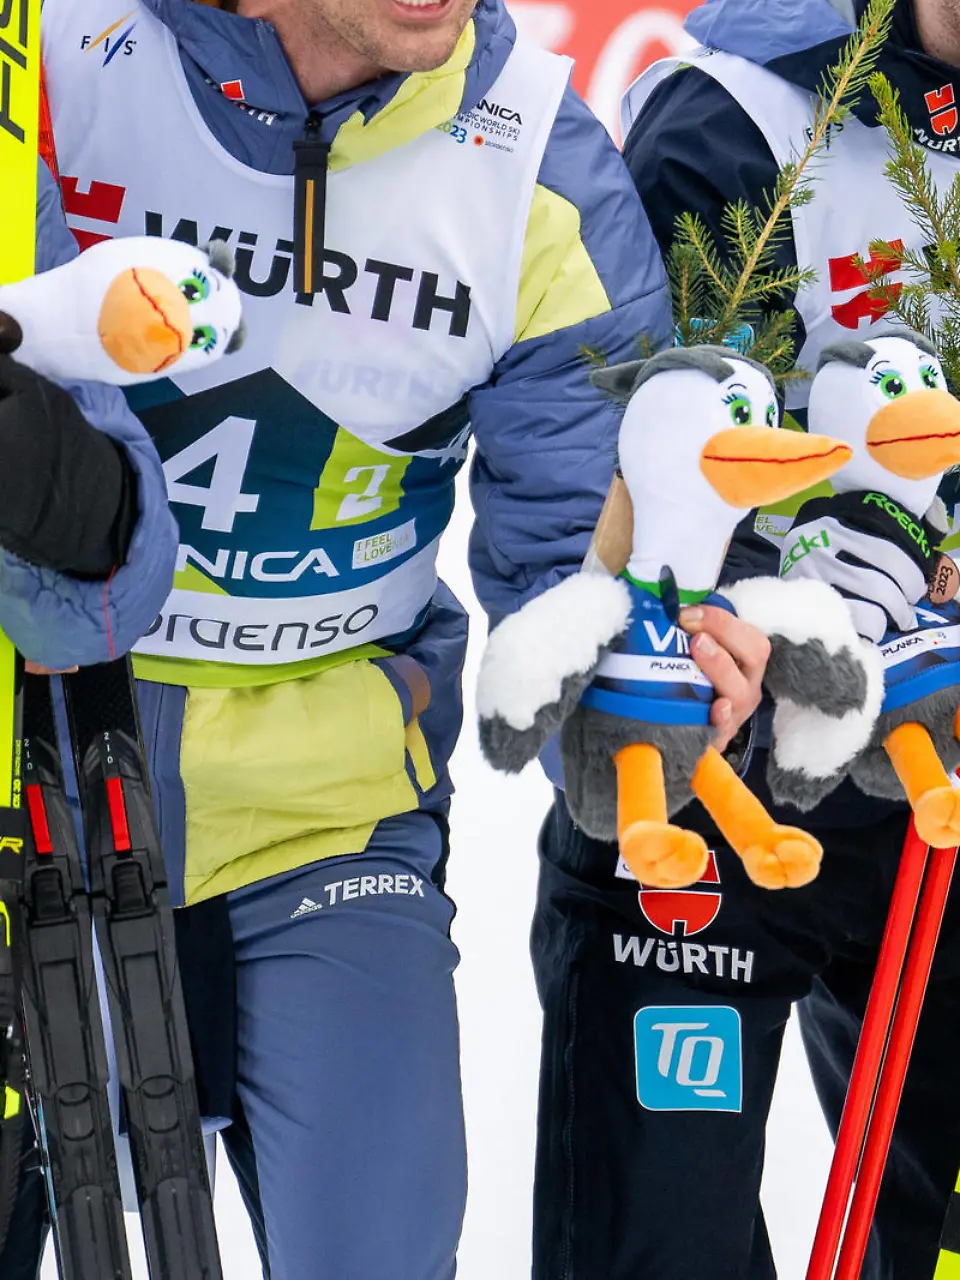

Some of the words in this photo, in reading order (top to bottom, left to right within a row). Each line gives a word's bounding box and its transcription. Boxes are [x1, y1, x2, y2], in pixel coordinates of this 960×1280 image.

[81, 33, 137, 57] FIS
[480, 117, 508, 131] WORLD
[161, 415, 259, 534] 4
[335, 464, 392, 521] 2
[364, 533, 392, 550] FEEL
[936, 564, 954, 595] 2023
[104, 732, 110, 740] 2
[324, 874, 425, 906] TERREX
[613, 933, 755, 984] WÜRTH
[650, 1022, 727, 1098] TQ
